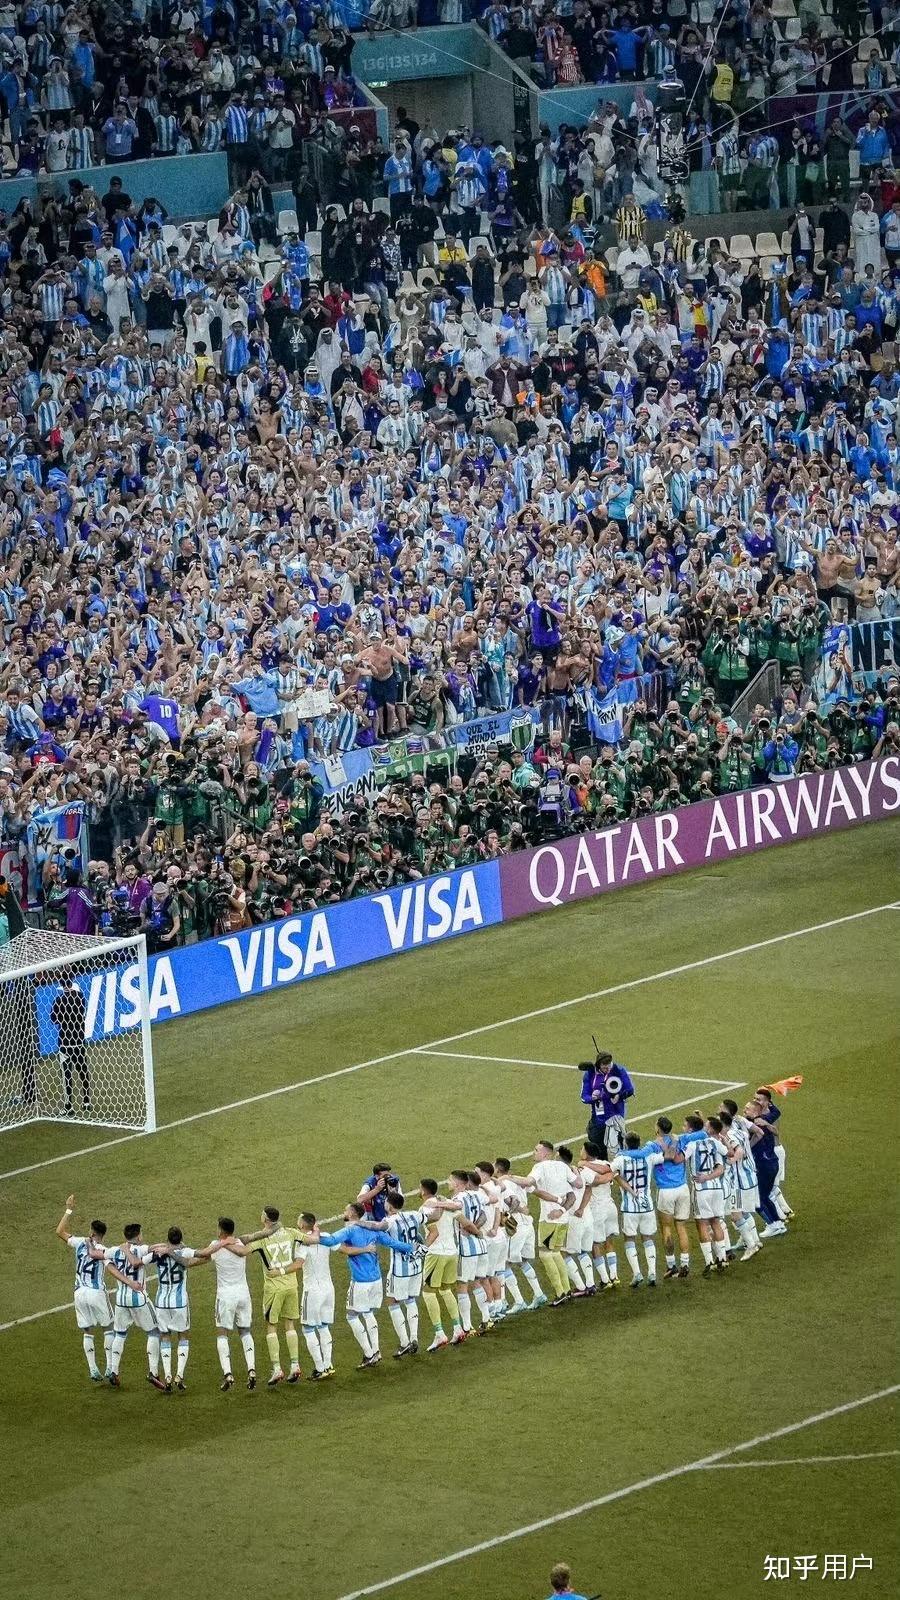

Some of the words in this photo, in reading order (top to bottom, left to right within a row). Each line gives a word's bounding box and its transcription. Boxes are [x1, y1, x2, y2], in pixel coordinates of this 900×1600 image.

[160, 704, 172, 719] 10
[466, 724, 482, 735] QUE
[487, 720, 500, 732] EL
[468, 731, 496, 745] MUNDO
[529, 813, 685, 906] QATAR
[705, 756, 900, 858] AIRWAYS
[371, 870, 484, 950] VISA
[218, 912, 337, 994] VISA
[77, 1253, 97, 1280] 14
[159, 1260, 185, 1285] 26
